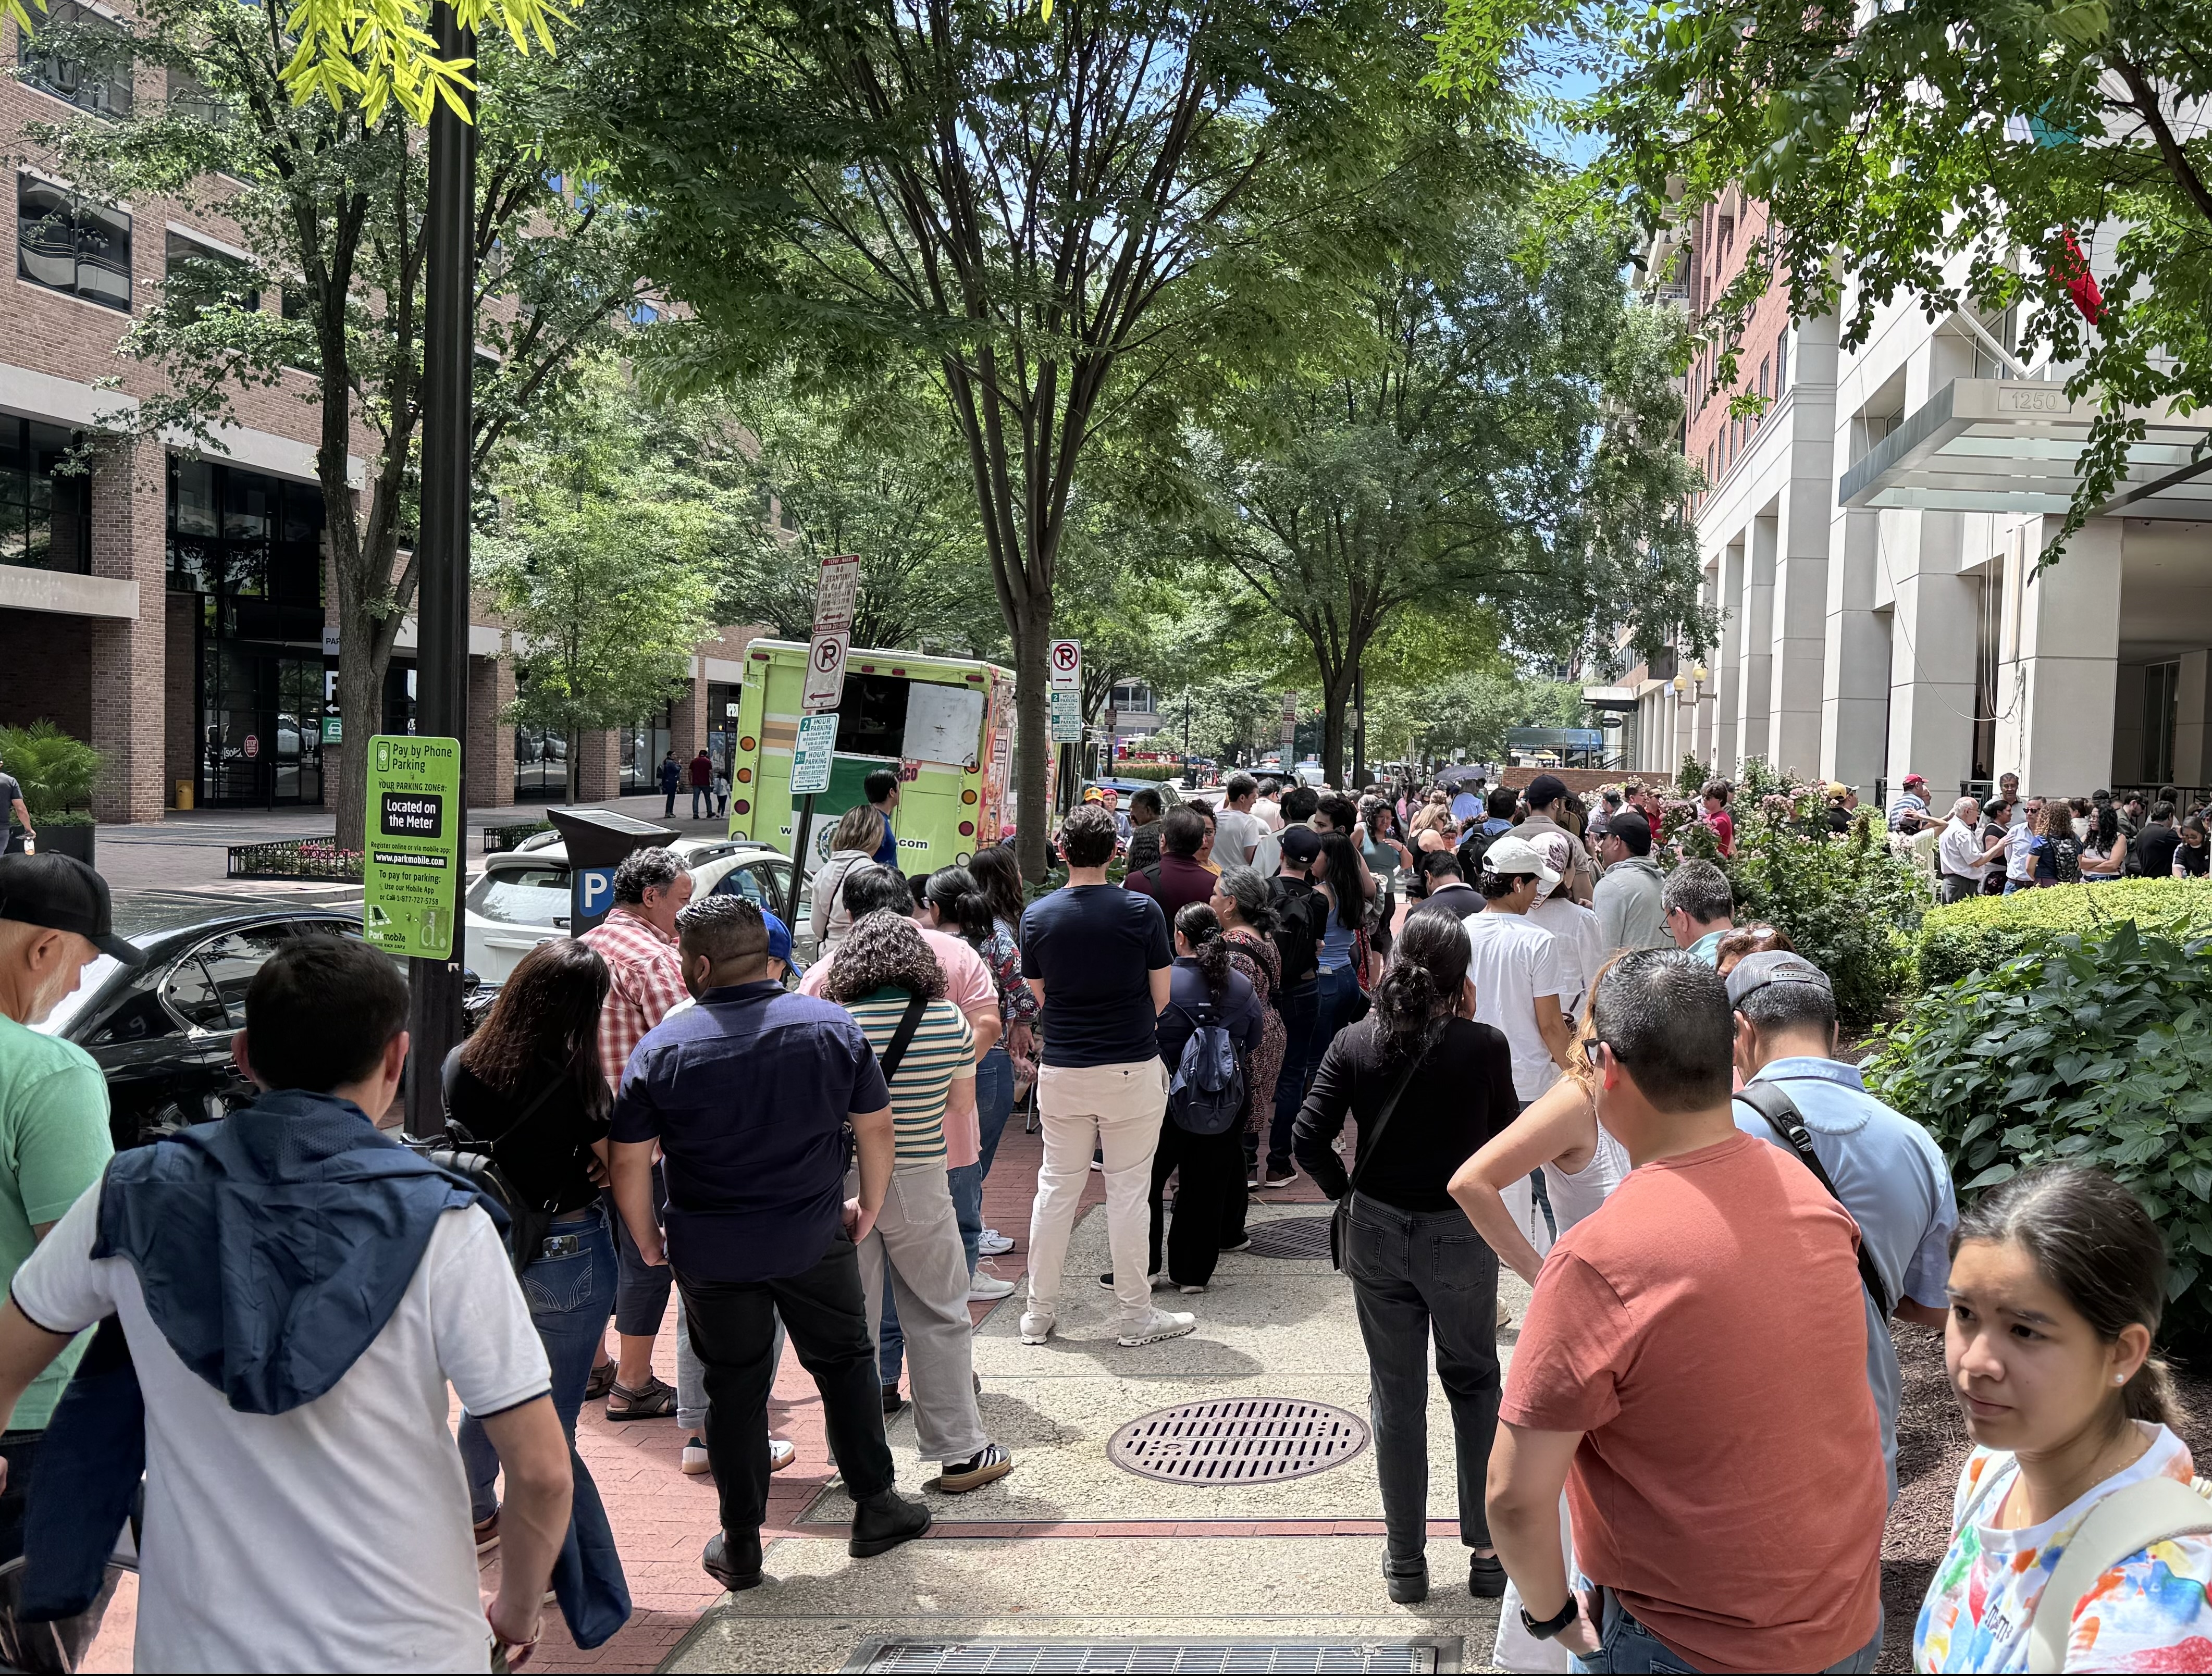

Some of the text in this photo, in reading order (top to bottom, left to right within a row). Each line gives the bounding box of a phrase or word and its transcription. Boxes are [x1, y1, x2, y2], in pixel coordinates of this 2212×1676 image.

[2012, 391, 2057, 410] 1250
[826, 573, 851, 582] STANDING
[803, 720, 808, 730] 2
[393, 743, 452, 758] Pay by Phone
[796, 754, 800, 762] 3
[392, 759, 425, 773] Parking
[379, 781, 447, 792] YOUR PARKING ZONE#:
[387, 799, 436, 814] Located on
[389, 814, 433, 829] the Meter
[376, 854, 444, 866] www.parkmobile.com
[379, 870, 441, 885] To pay for parking:
[424, 886, 434, 895] App
[585, 873, 607, 908] P
